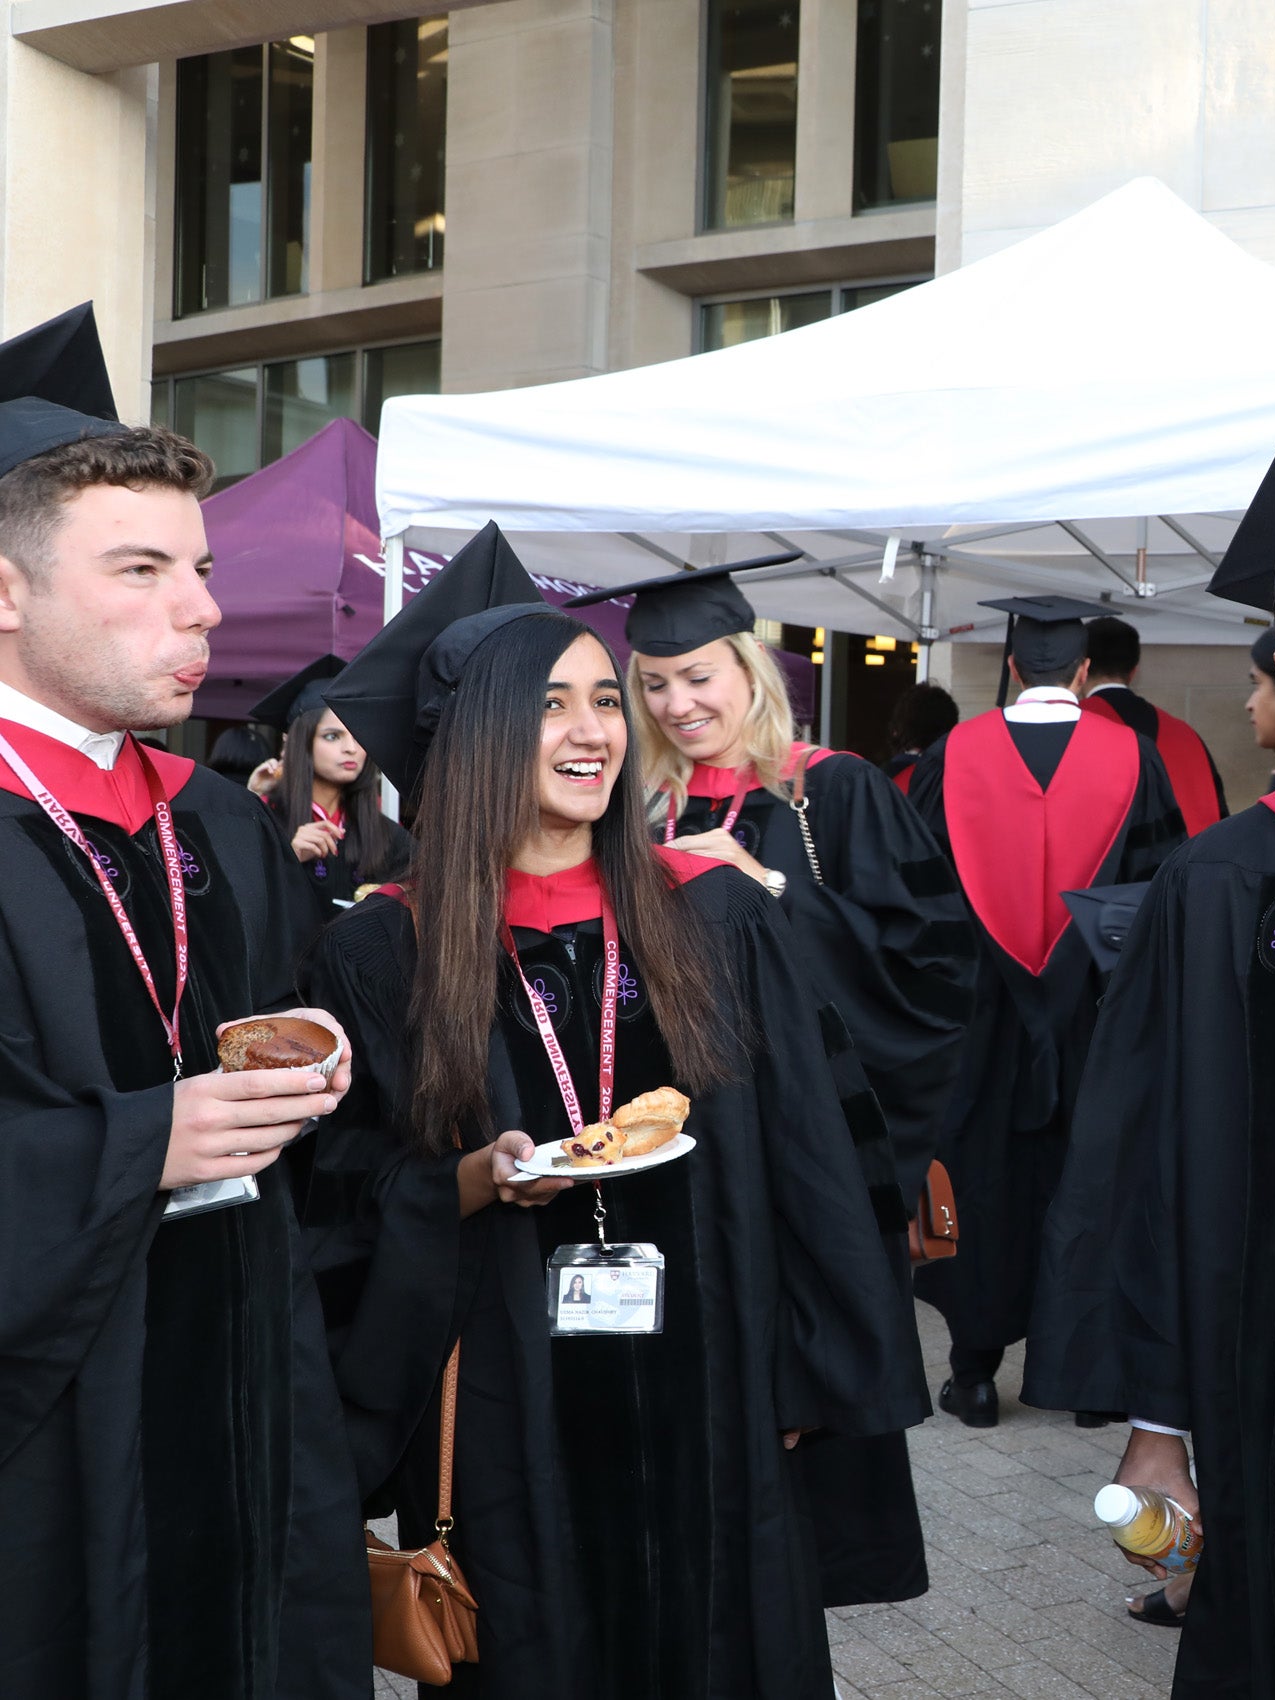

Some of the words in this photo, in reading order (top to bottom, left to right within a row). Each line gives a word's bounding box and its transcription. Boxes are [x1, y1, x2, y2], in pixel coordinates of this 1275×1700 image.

[103, 880, 154, 984] UNIVERSITY
[155, 801, 186, 935] COMMENCEMENT
[602, 940, 617, 1075] COMMENCEMENT
